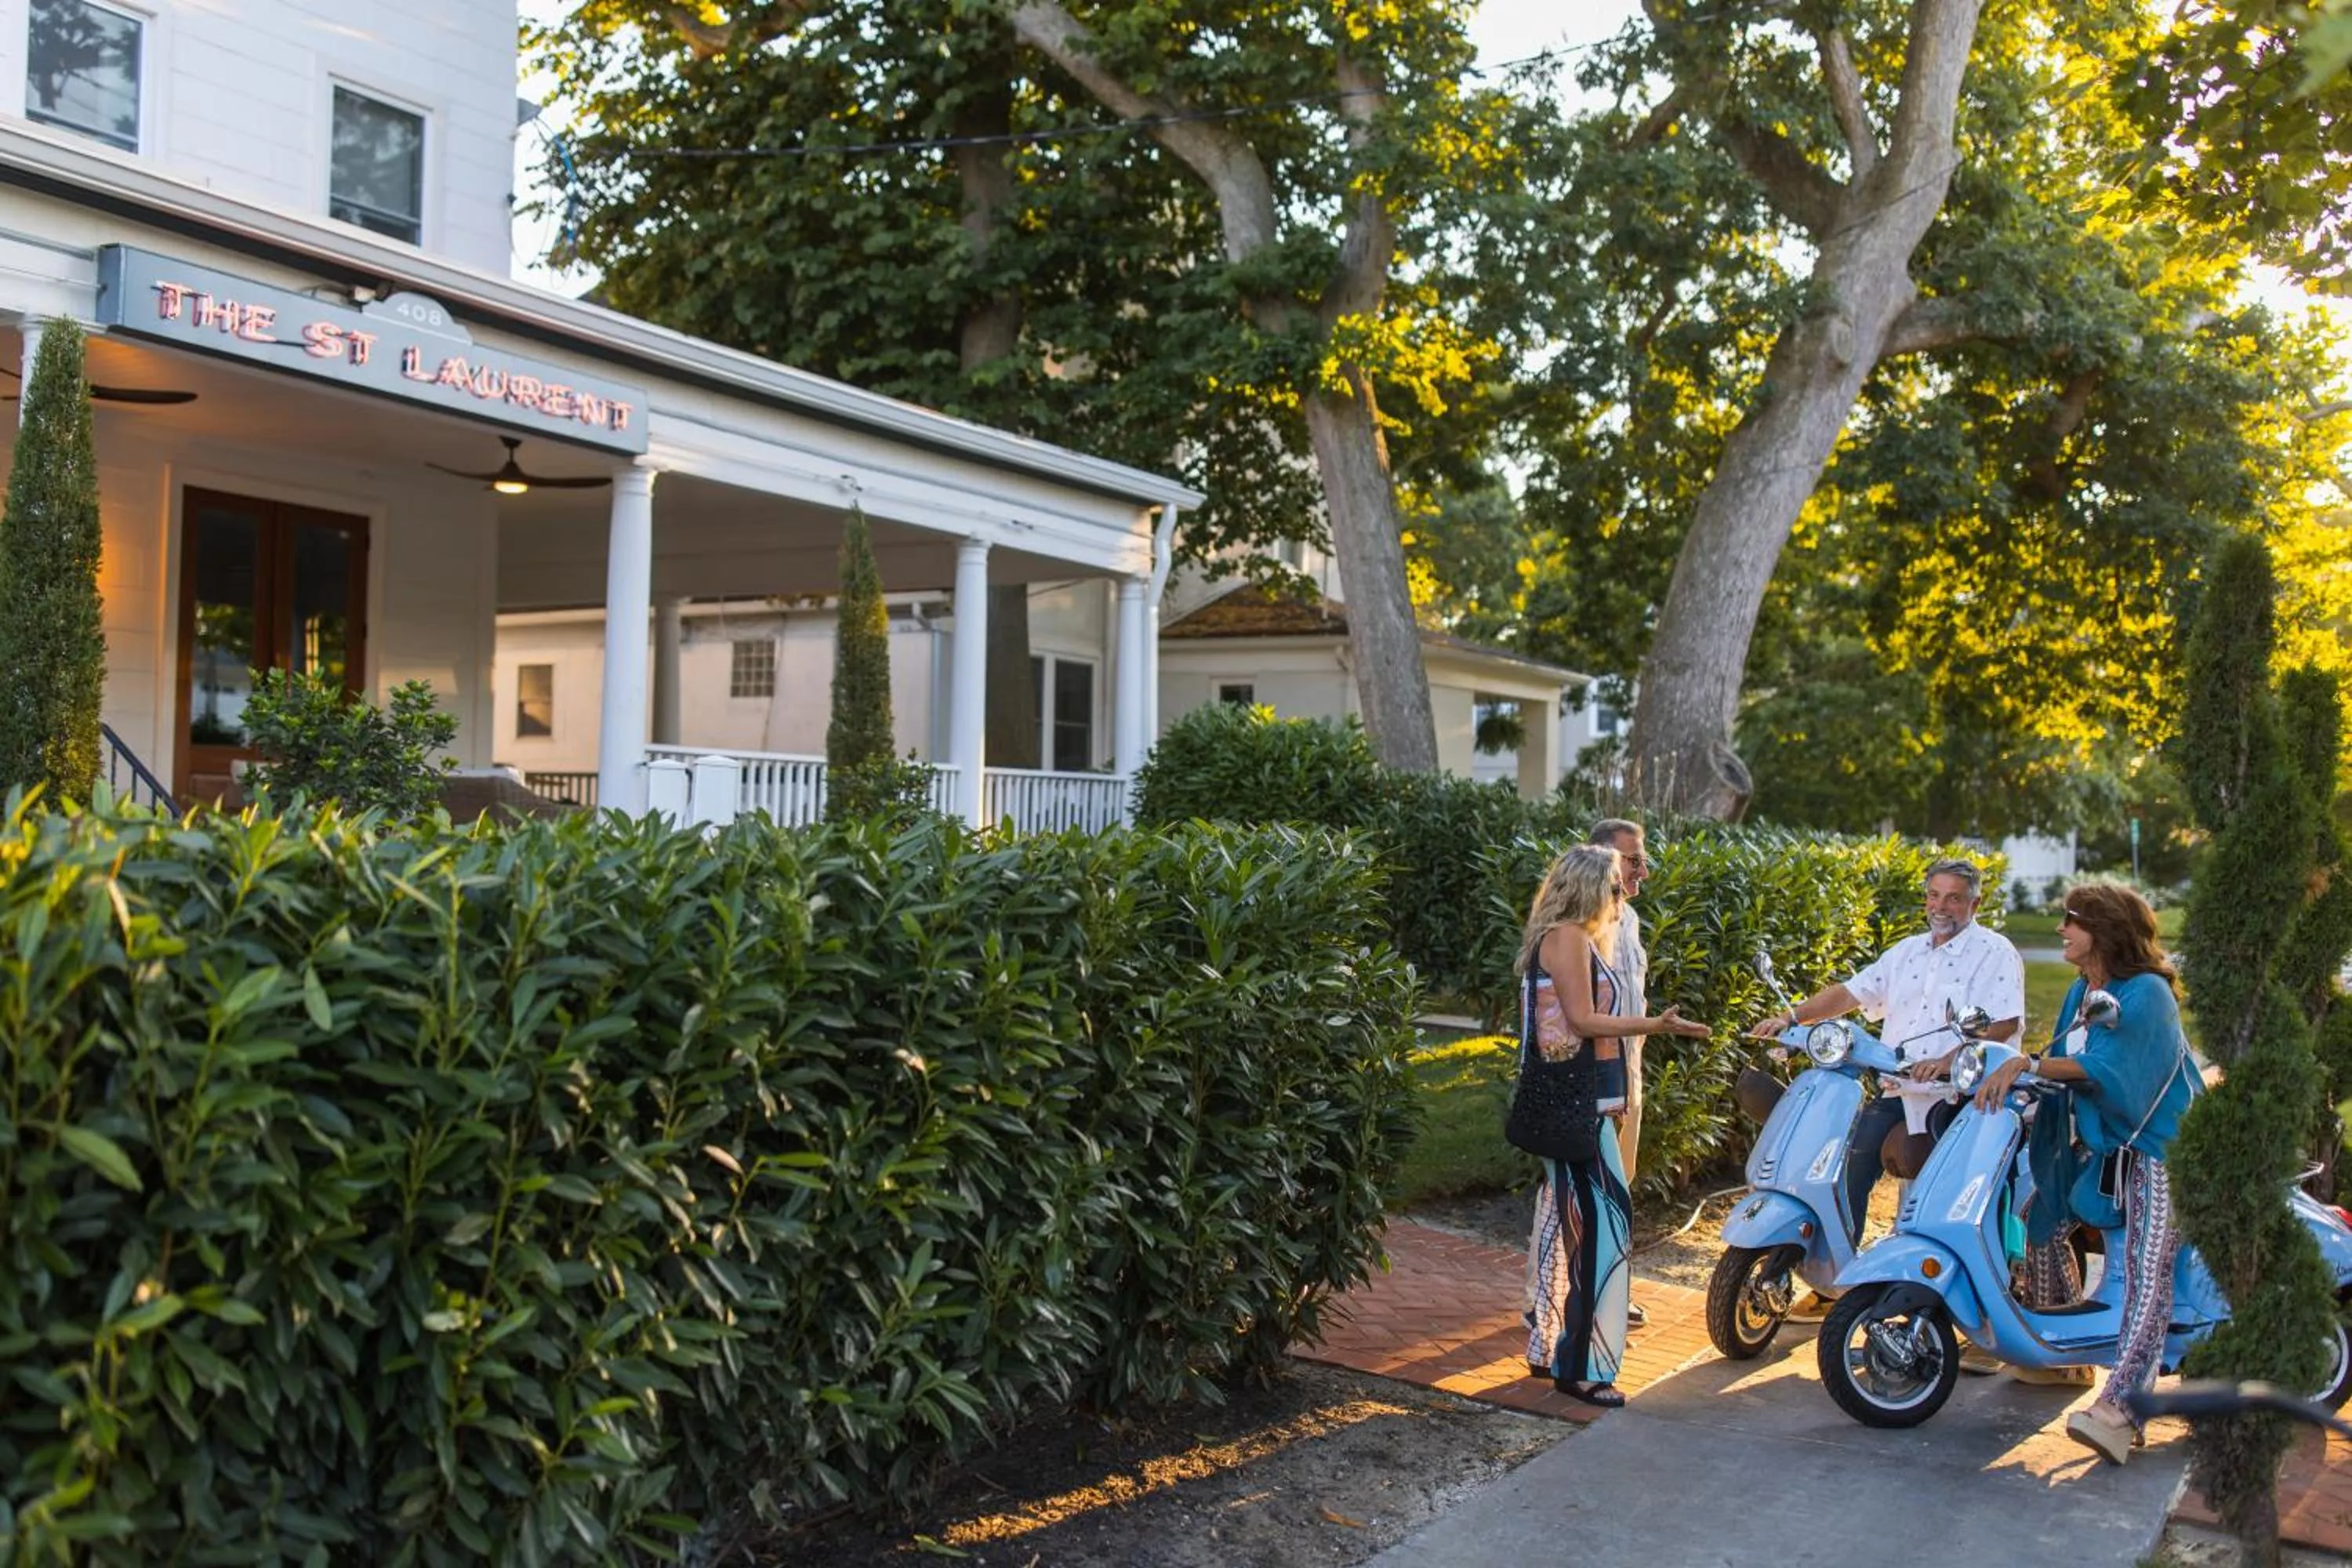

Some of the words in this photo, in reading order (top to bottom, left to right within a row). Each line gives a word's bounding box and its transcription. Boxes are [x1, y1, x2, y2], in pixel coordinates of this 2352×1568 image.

[155, 279, 278, 343] THE
[301, 320, 378, 367] ST
[401, 344, 633, 431] LAURENT
[396, 302, 443, 326] 408
